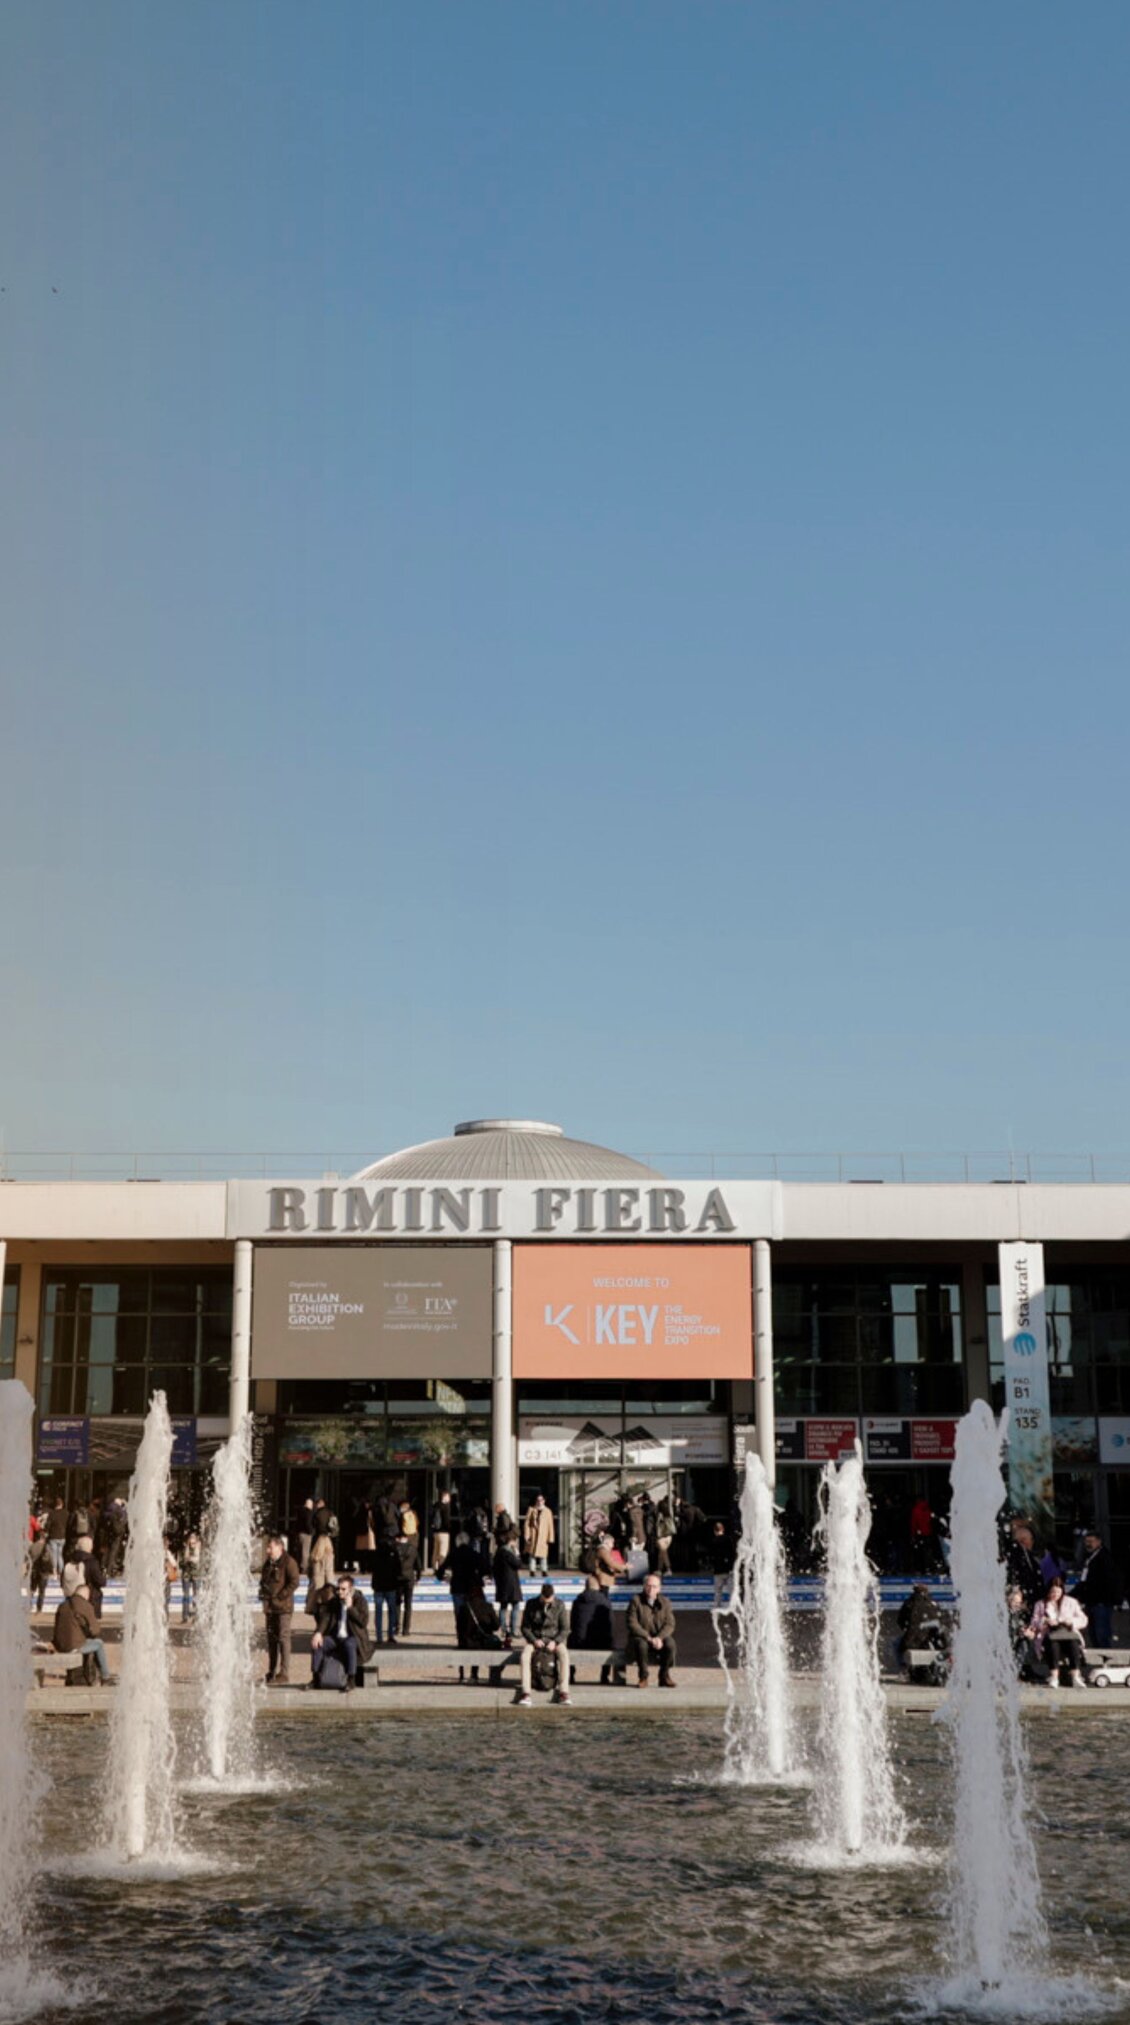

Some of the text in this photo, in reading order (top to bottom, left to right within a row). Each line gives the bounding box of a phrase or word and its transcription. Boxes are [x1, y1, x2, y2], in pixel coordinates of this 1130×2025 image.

[267, 1186, 737, 1232] RIMINI FIERA
[593, 1277, 670, 1288] WELCOME TO
[289, 1292, 340, 1303] ITALIAN
[1014, 1258, 1030, 1328] Statkraft
[288, 1303, 365, 1314] EXHIBITION
[664, 1305, 683, 1314] THE
[288, 1314, 336, 1325] GROUP
[595, 1304, 660, 1345] KEY
[664, 1315, 702, 1325] ENERGY
[664, 1325, 721, 1335] TRANSITION
[664, 1335, 690, 1345] EXPO
[1014, 1387, 1030, 1399] B1
[1015, 1408, 1041, 1416] STAND
[1015, 1417, 1039, 1429] 135
